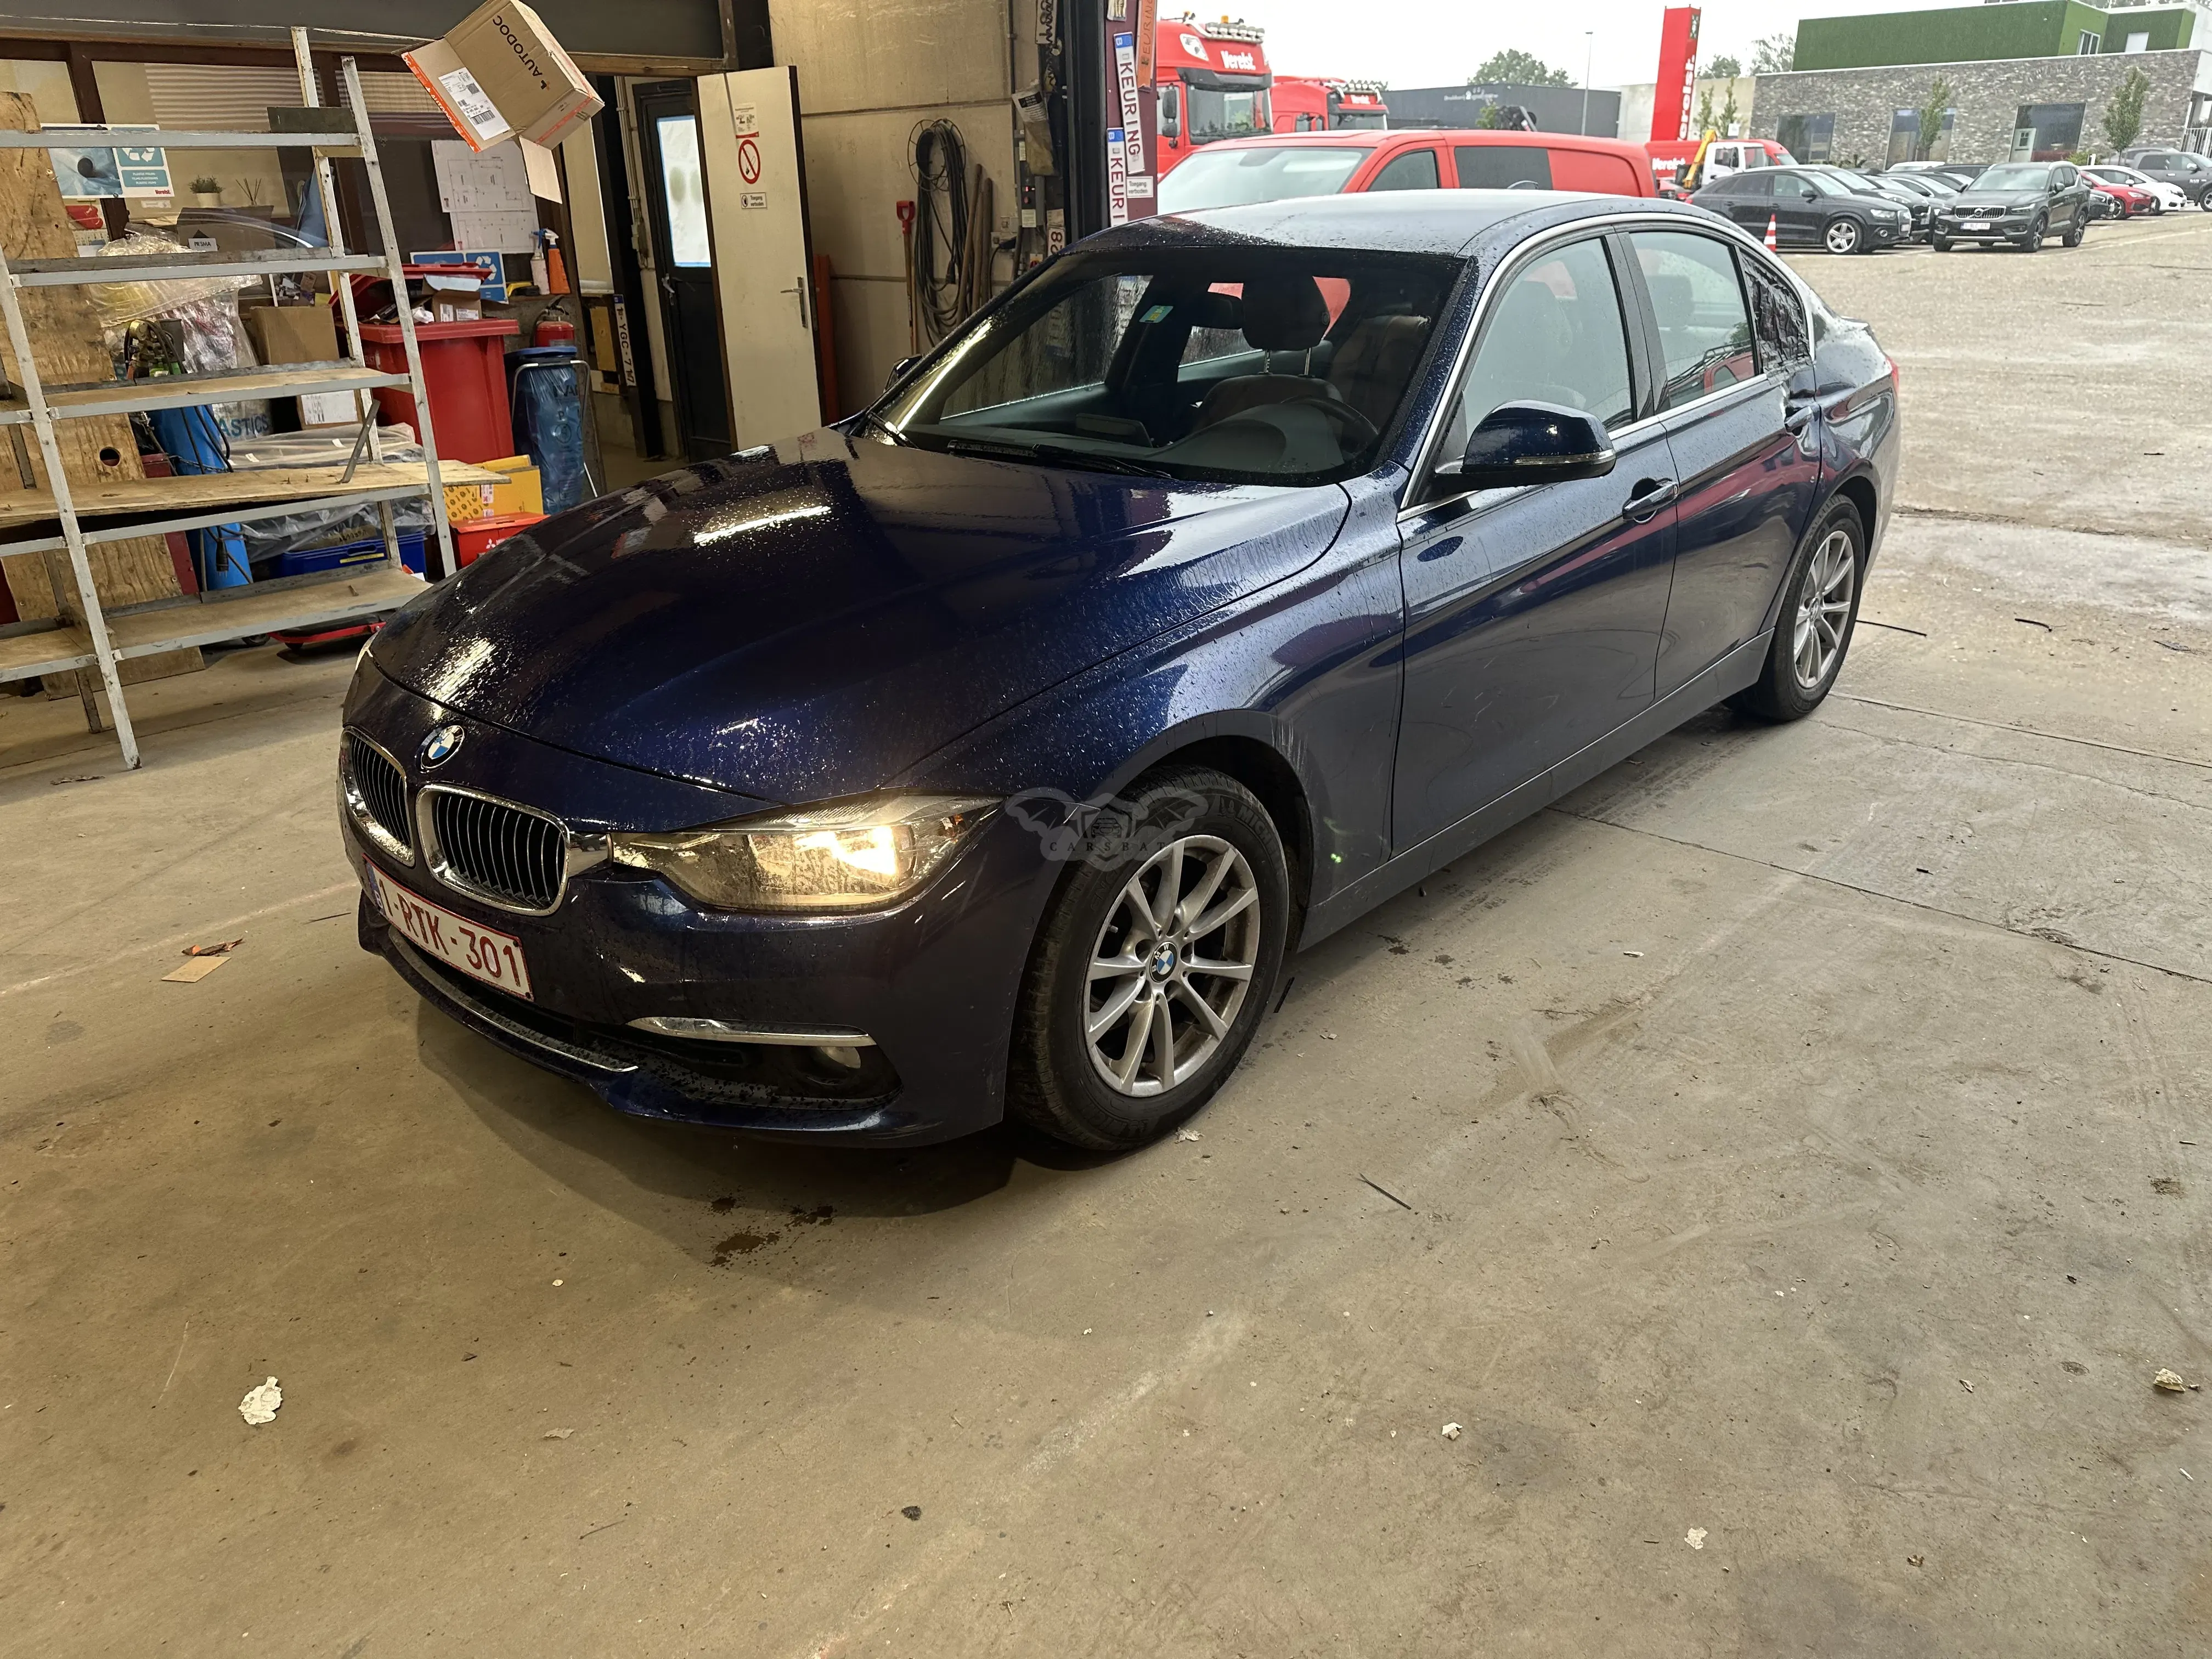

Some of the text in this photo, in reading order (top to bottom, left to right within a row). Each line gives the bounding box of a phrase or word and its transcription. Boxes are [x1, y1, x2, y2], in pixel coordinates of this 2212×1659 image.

[493, 15, 543, 76] AUTODOC
[1120, 61, 1141, 155] KEURING
[1110, 157, 1125, 227] KEURI
[379, 878, 521, 988] 1-RTK-301
[1152, 943, 1169, 973] BMW
